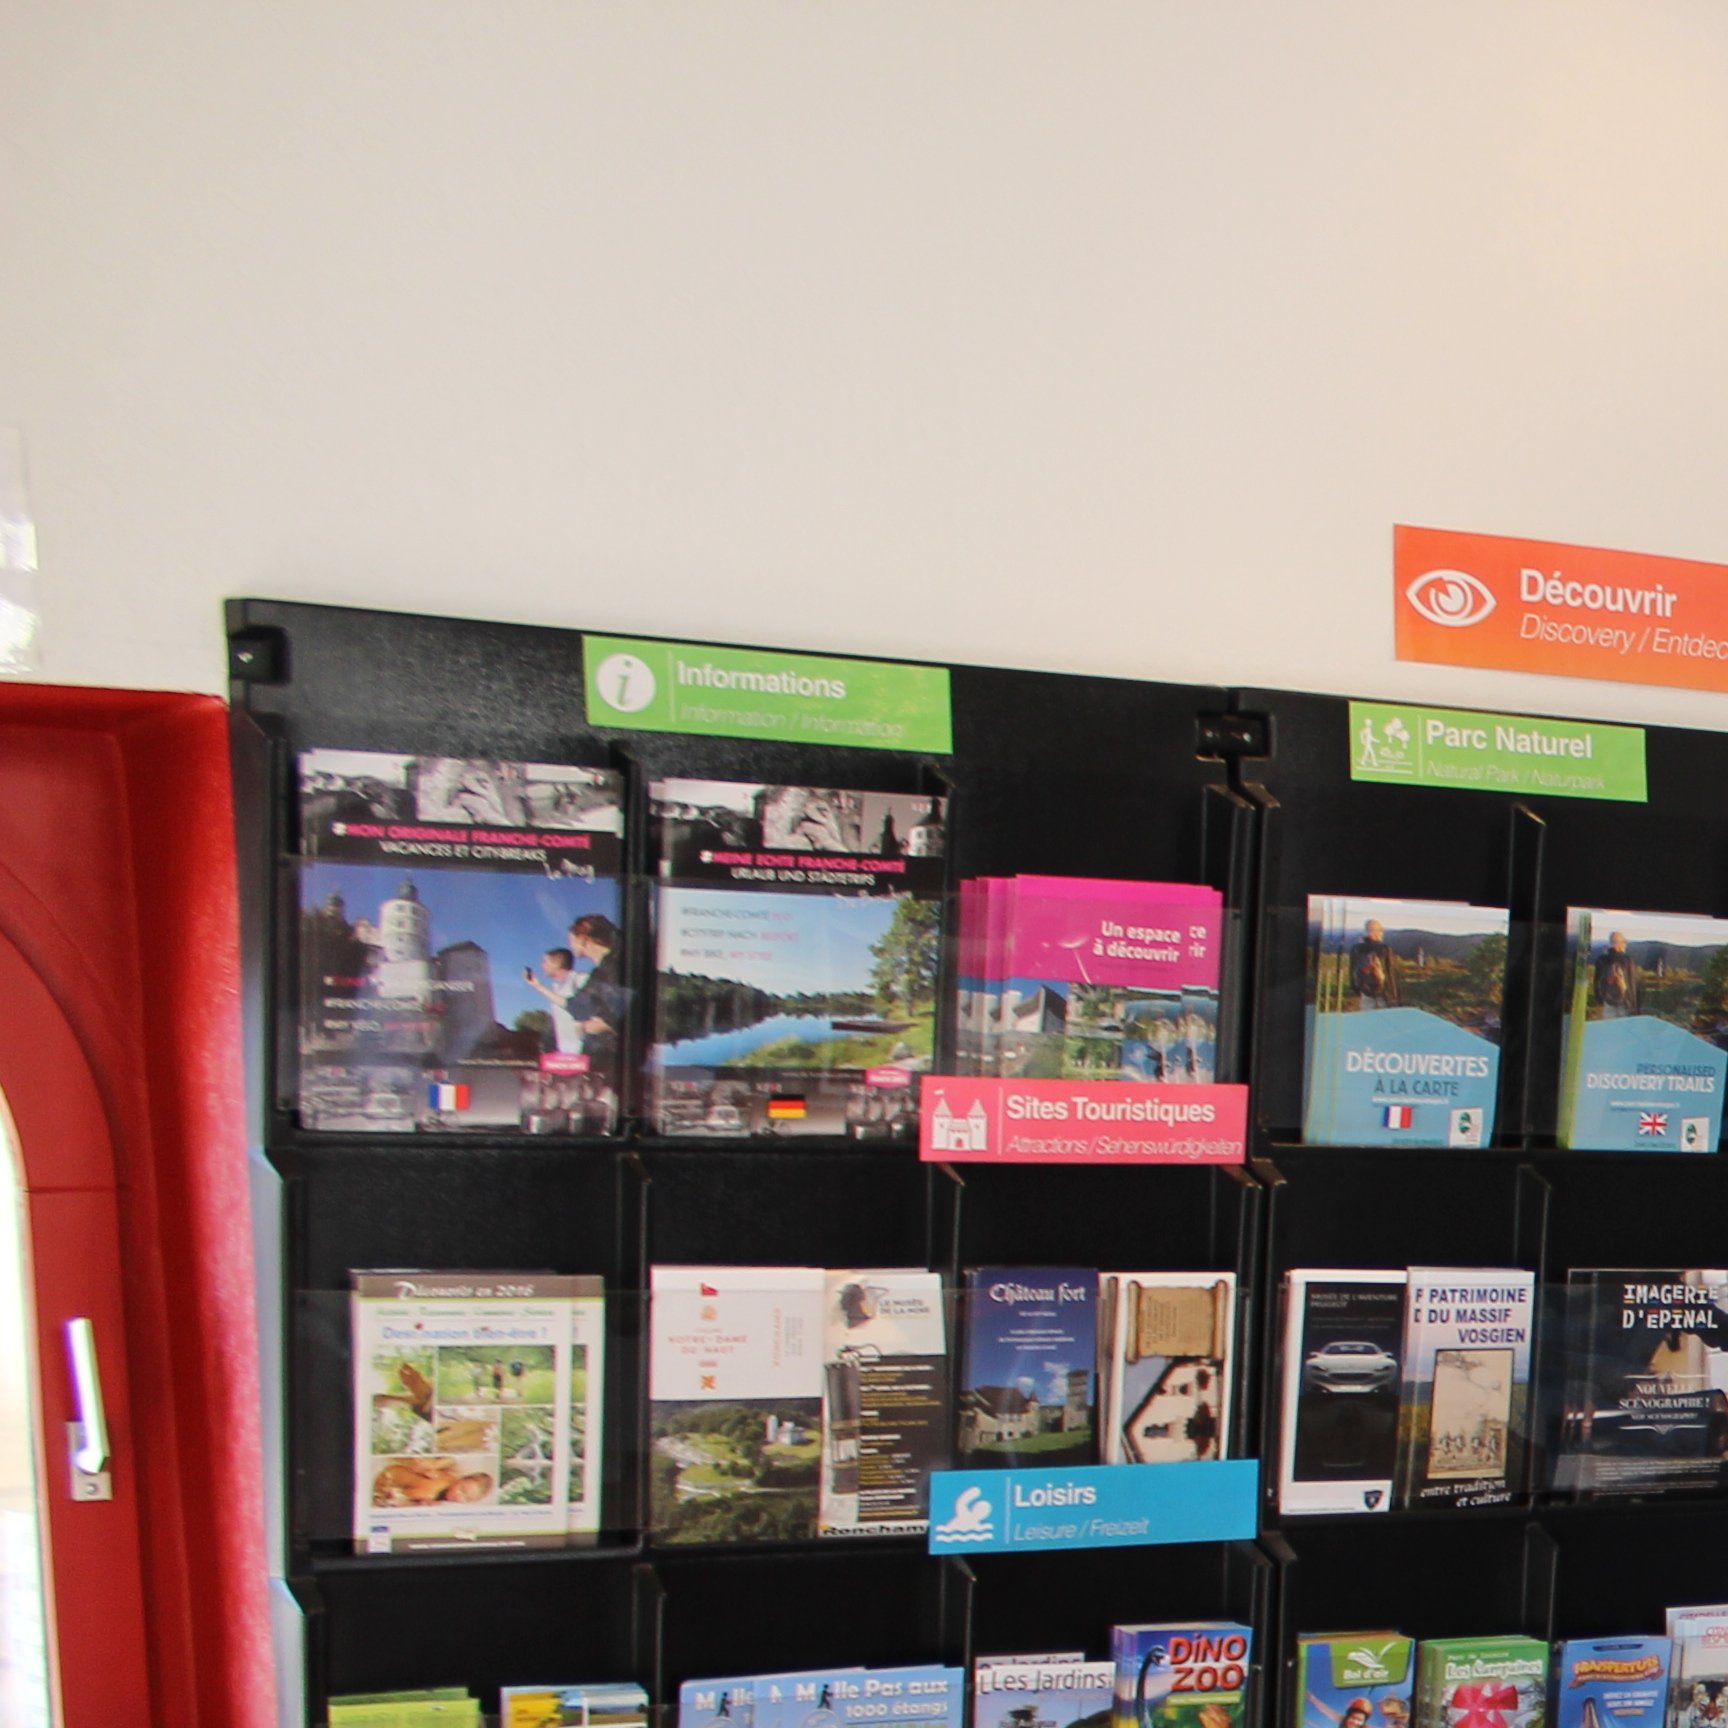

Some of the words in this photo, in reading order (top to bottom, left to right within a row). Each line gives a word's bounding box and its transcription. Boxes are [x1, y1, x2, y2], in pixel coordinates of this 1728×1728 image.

[1520, 568, 1677, 618] Découvrir
[1520, 613, 1635, 654] Discovery
[1637, 627, 1650, 653] /
[677, 660, 846, 700] Informations
[1427, 719, 1487, 751] Parc
[1495, 726, 1592, 759] Naturel
[1101, 919, 1123, 937] Un
[1127, 924, 1180, 946] espace
[1093, 938, 1104, 955] à
[1107, 940, 1180, 963] découvrir
[1346, 1047, 1489, 1077] DÉCOUVERTES
[1636, 1064, 1716, 1078] PERSONALISED
[1374, 1075, 1386, 1095] À
[1389, 1079, 1411, 1095] LA
[1413, 1079, 1460, 1097] CARTE
[1587, 1072, 1665, 1091] DISCOVERY
[1667, 1075, 1715, 1094] TRAILS
[1007, 1094, 1069, 1120] Sites
[1075, 1097, 1215, 1127] Touristiques
[1007, 1135, 1087, 1154] Attractions
[989, 1282, 1056, 1306] Château
[1057, 1283, 1087, 1305] fort
[1429, 1287, 1527, 1304] PATRIMOINE
[1623, 1284, 1719, 1305] IMAGERIE
[1428, 1308, 1450, 1323] DU
[1455, 1308, 1511, 1323] MASSIF
[1458, 1328, 1525, 1344] VOSGIEN
[1014, 1482, 1097, 1508] Loisirs
[1014, 1521, 1076, 1542] Leisure
[1089, 1516, 1149, 1537] Freizeit
[865, 1679, 901, 1697] Pas
[908, 1680, 949, 1695] aux
[992, 1671, 1028, 1690] Les
[1033, 1669, 1106, 1693] Jardins
[1171, 1664, 1245, 1692] ZOO
[846, 1704, 888, 1718] 1000
[892, 1702, 948, 1718] étangs
